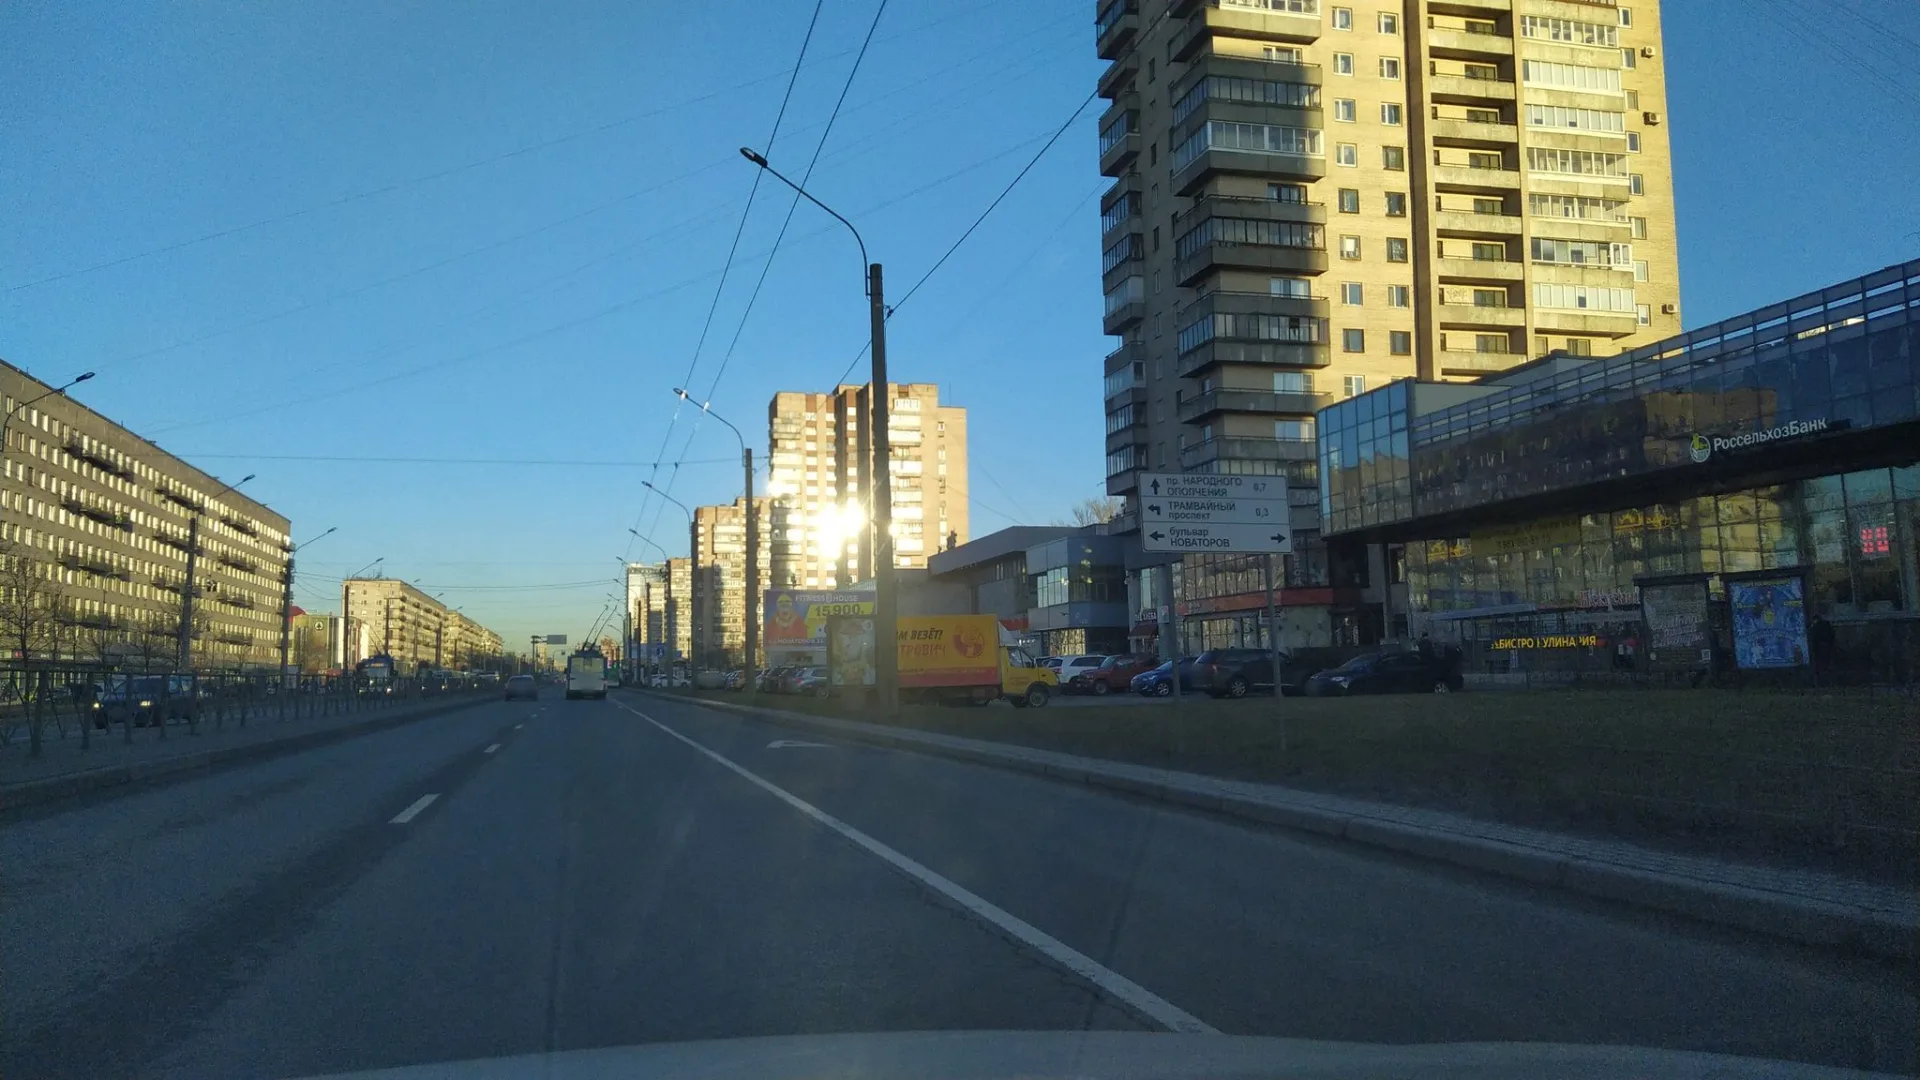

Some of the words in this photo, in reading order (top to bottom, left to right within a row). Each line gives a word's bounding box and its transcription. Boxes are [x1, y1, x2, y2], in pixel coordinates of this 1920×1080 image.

[1713, 417, 1828, 451] РоссельхозБанк
[1166, 478, 1180, 487] пр.
[1183, 477, 1243, 487] НАРОДНОГО
[1167, 487, 1228, 497] ОПОЛЧЕНИЯ
[1253, 483, 1267, 493] 0,7
[1168, 500, 1236, 511] ТРАМВАЙНЫЙ
[1168, 512, 1211, 520] проспект
[1255, 508, 1269, 518] 0,3
[1169, 527, 1209, 538] бульвар
[1170, 538, 1230, 547] НОВАТОРОВ
[795, 594, 826, 602] FITNESS
[833, 594, 859, 602] HOUSE
[899, 643, 947, 657] ТРОВИЧ
